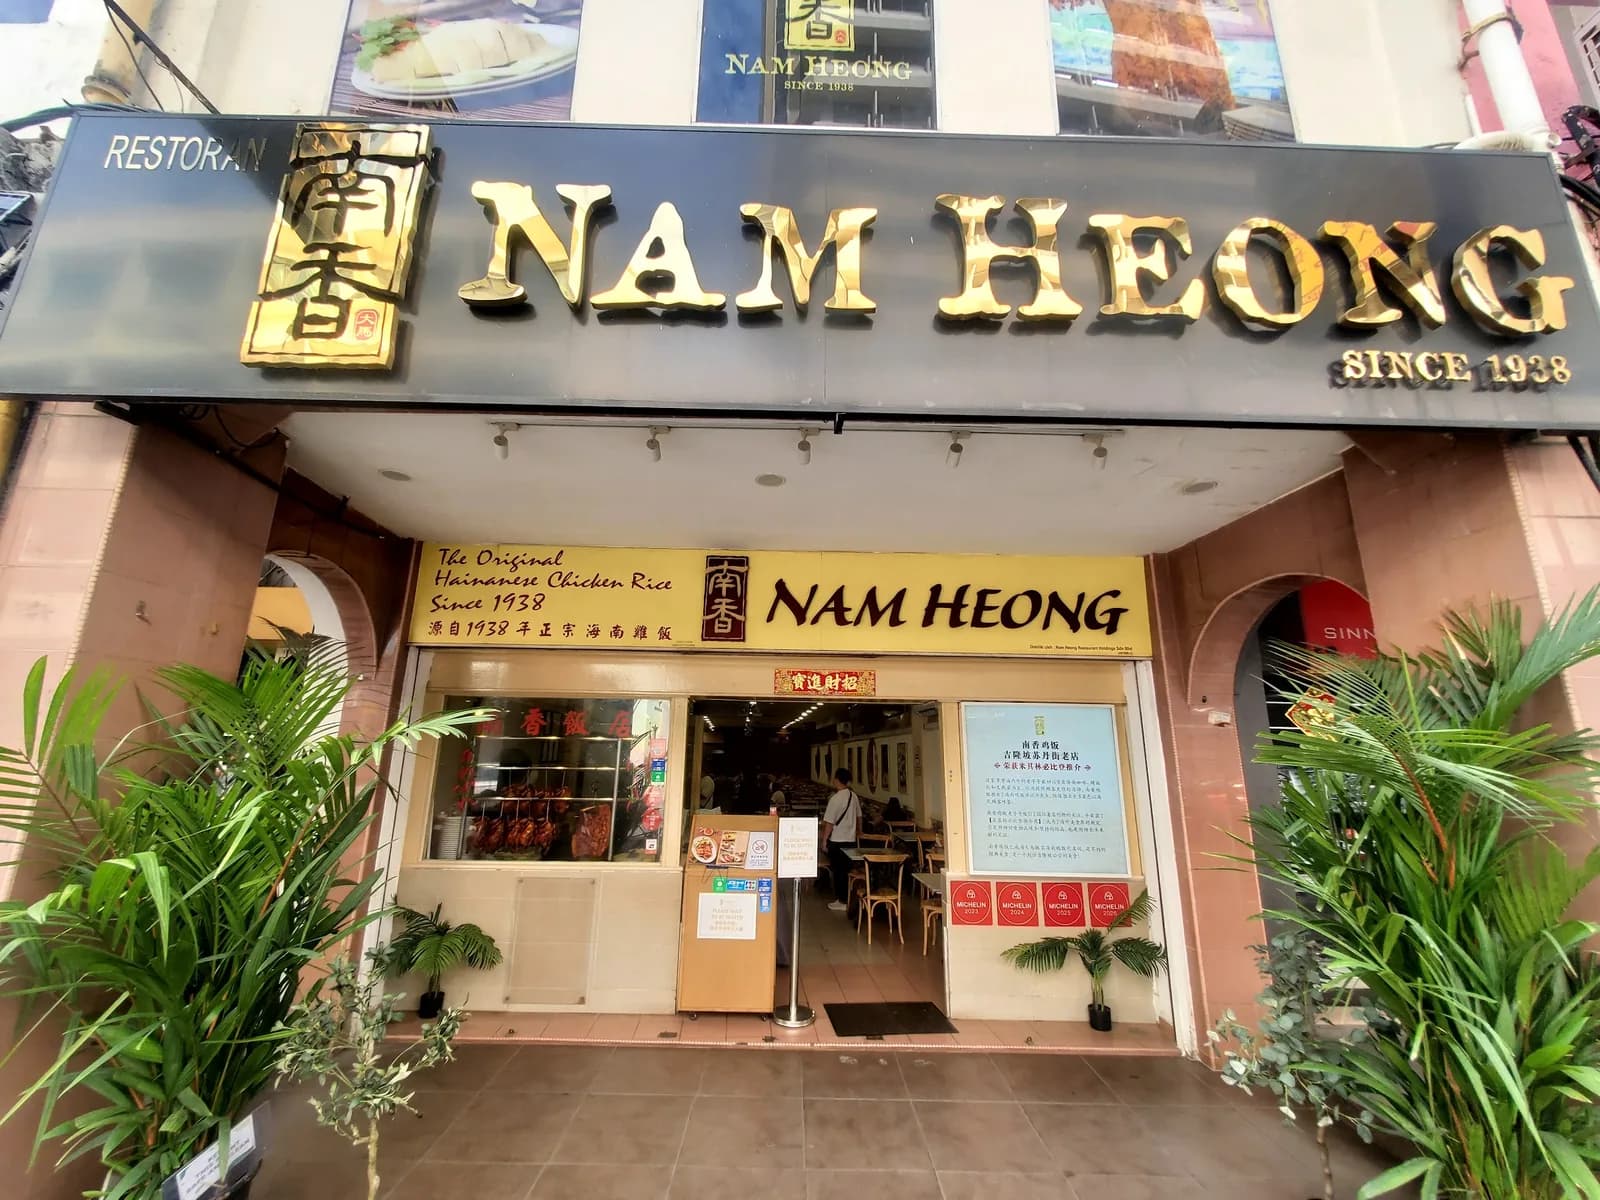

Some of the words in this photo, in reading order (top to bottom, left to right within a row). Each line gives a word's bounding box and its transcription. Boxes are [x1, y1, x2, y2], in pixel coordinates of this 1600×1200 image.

[725, 54, 795, 75] NAM
[804, 55, 912, 80] HEONG
[784, 80, 824, 91] SINCE
[829, 82, 854, 92] 1938
[104, 134, 268, 172] RESTORAN
[458, 181, 878, 314] NAM
[935, 194, 1576, 338] HEONG
[1342, 349, 1473, 383] SINCE
[1486, 352, 1572, 386] 1938
[439, 549, 468, 566] The
[476, 549, 565, 573] Original
[434, 569, 539, 589] Hainanese
[547, 571, 624, 591] Chicken
[631, 573, 673, 591] Rice
[430, 594, 483, 613] Since
[493, 593, 547, 613] 1938
[766, 578, 908, 627] NAM
[921, 583, 1129, 636] HEONG
[957, 901, 986, 909] MICHELIN
[1002, 902, 1031, 910] MICHELIN
[1049, 903, 1078, 911] MICHELIN
[1095, 903, 1124, 911] MICHELIN
